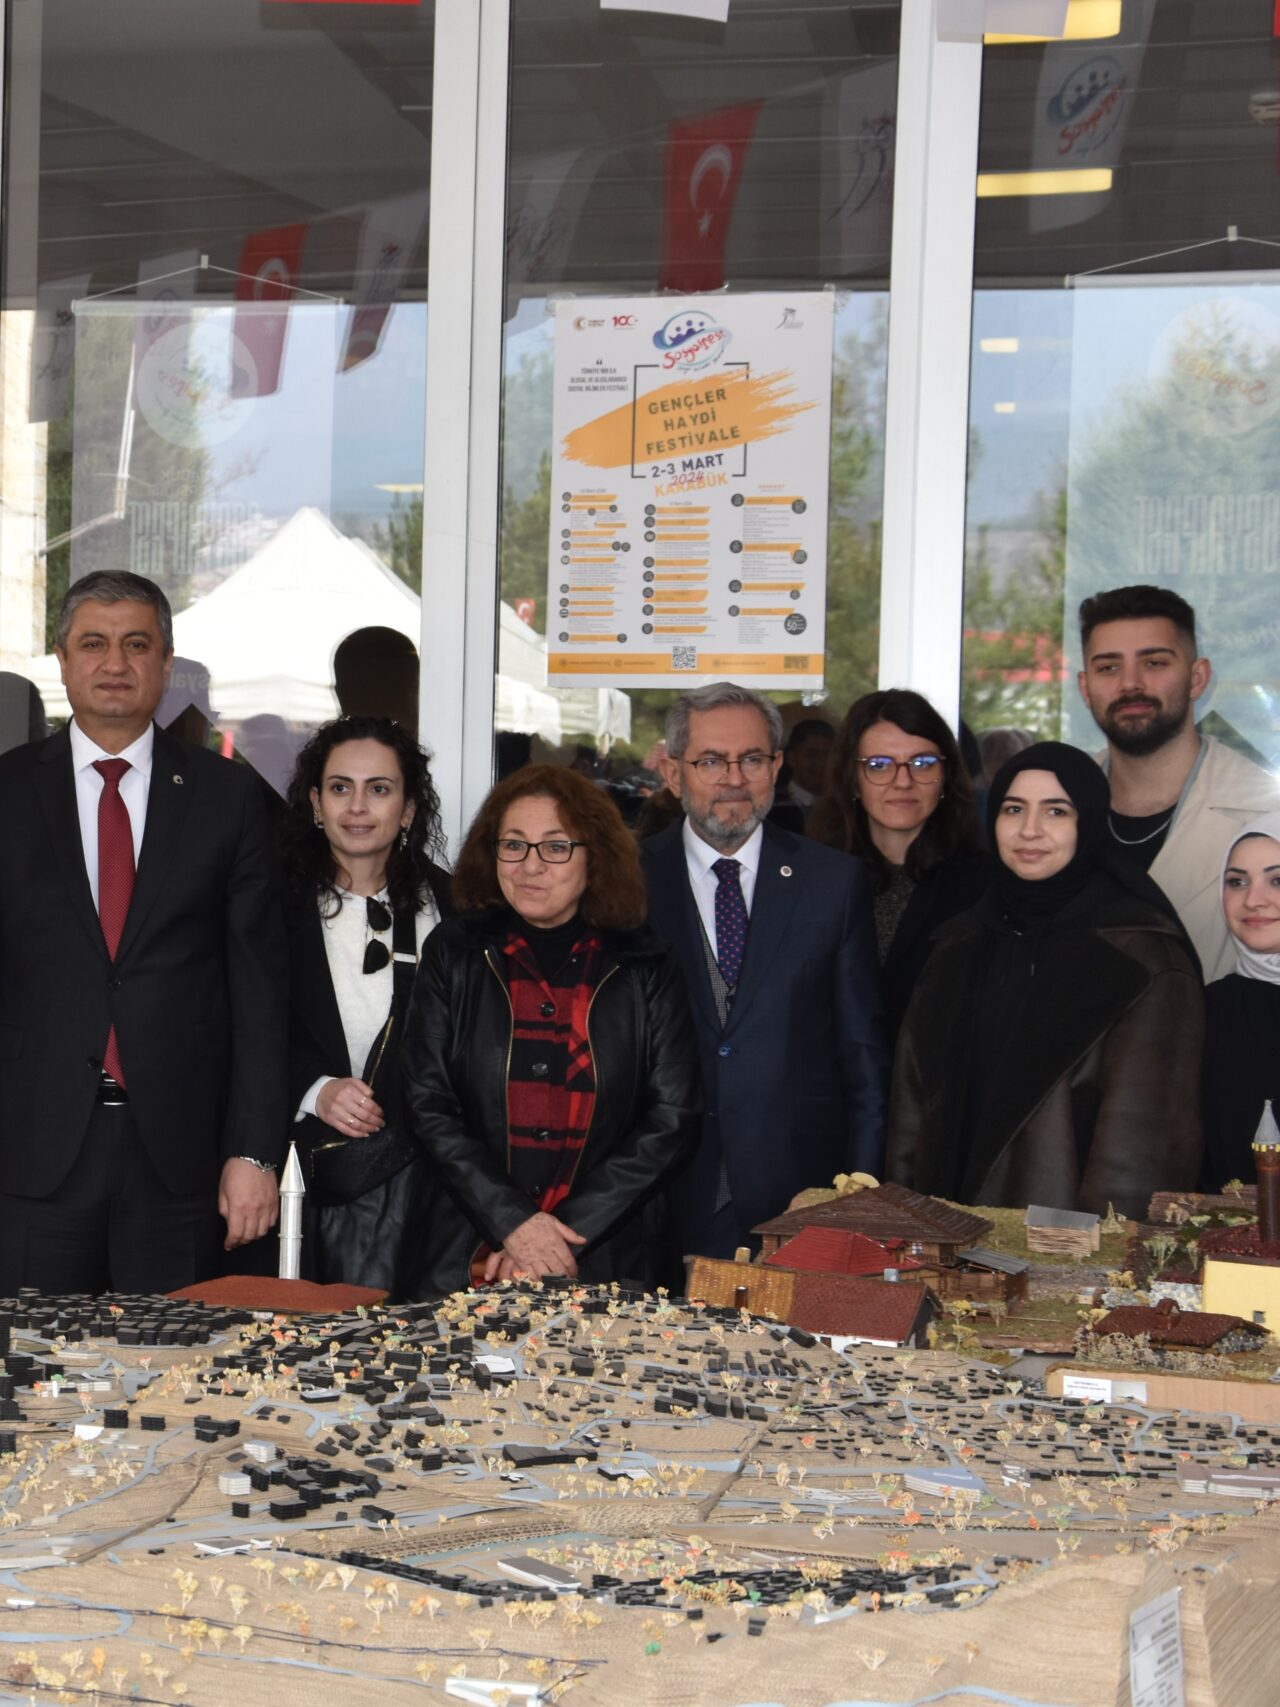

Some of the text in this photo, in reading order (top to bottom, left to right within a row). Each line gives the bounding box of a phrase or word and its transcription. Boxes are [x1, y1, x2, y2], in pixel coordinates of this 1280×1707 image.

[648, 388, 727, 415] GENÇLER
[664, 409, 717, 432] HAYDİ
[646, 425, 741, 455] FESTİVALE
[651, 453, 724, 478] 2-3 MART
[654, 472, 729, 498] KARABÜK
[670, 471, 705, 487] 2024
